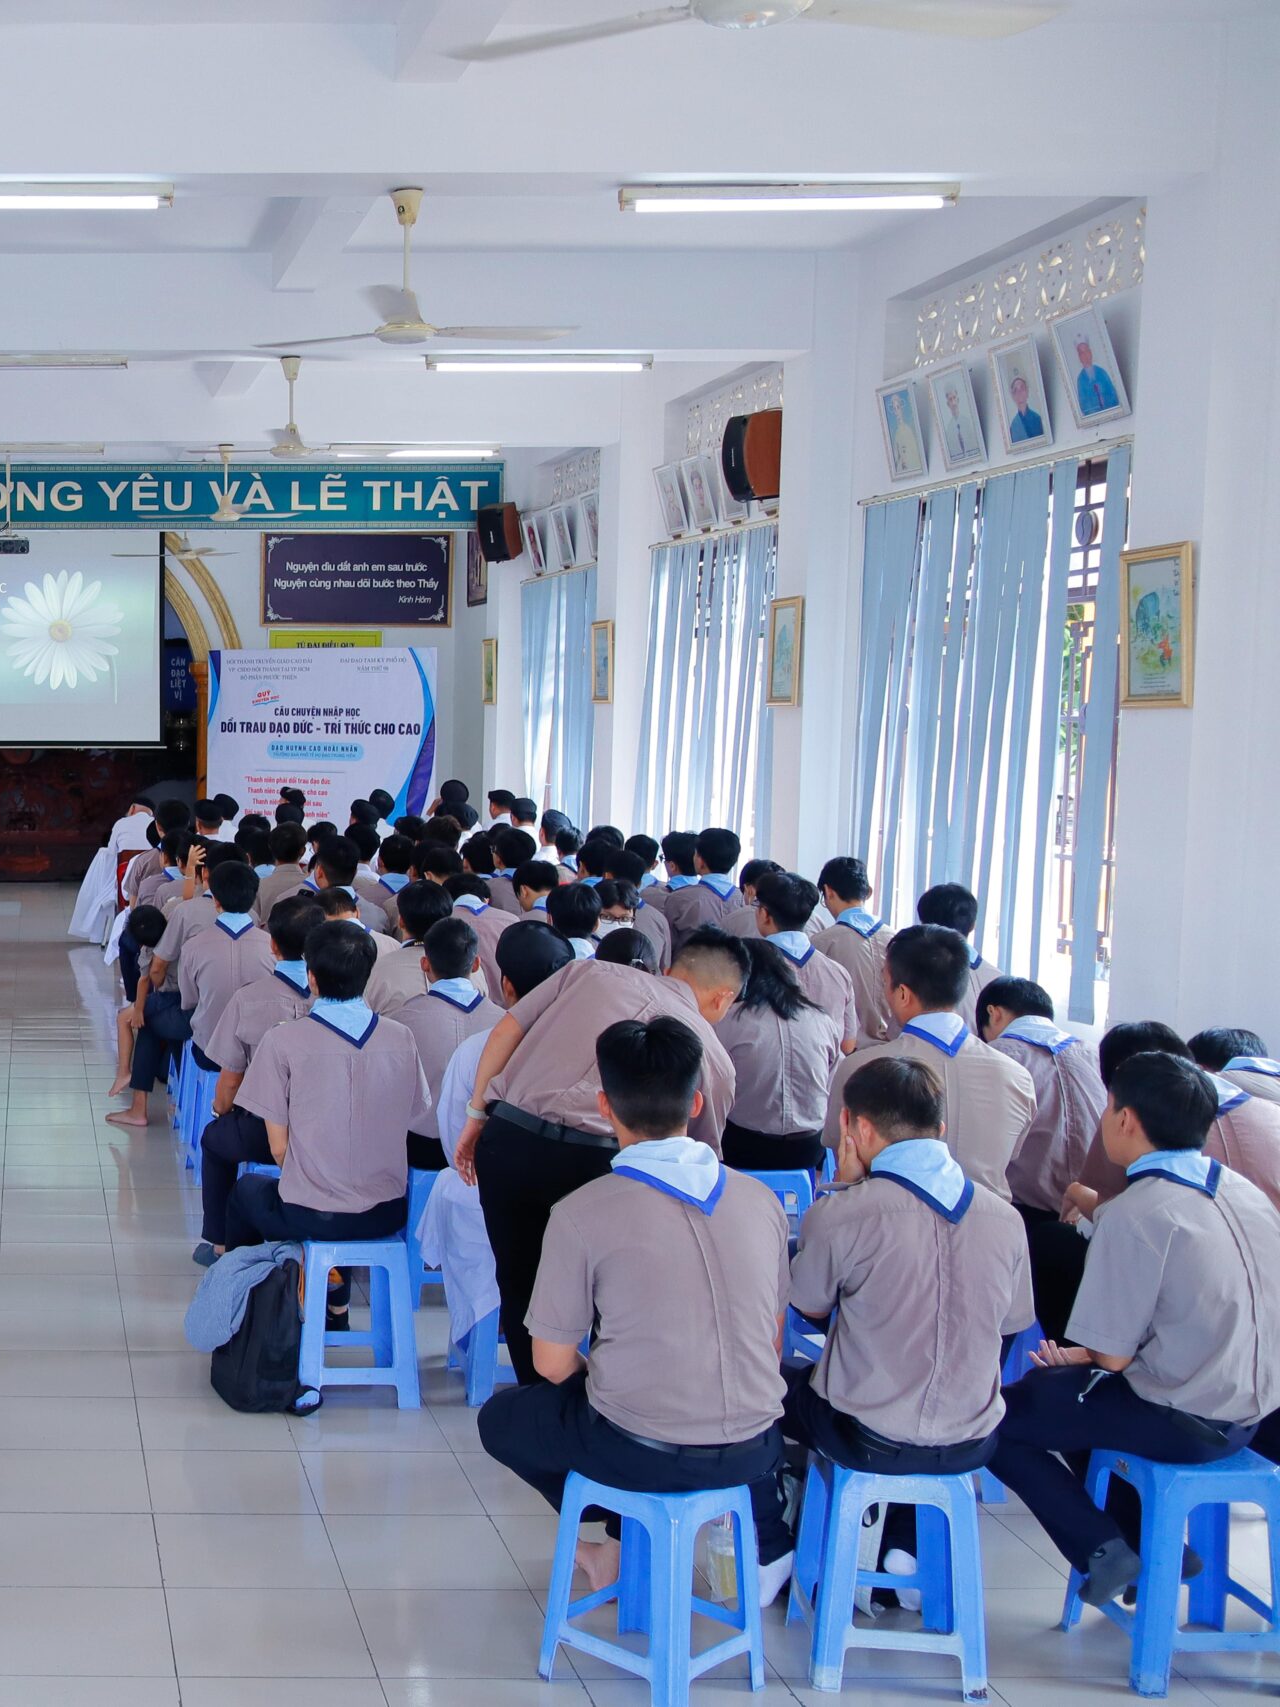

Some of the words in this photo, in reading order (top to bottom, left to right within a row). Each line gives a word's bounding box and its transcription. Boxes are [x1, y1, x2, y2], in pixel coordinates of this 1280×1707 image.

[97, 473, 192, 511] YÊU
[209, 473, 275, 511] VÀ
[290, 473, 347, 511] LẼ
[363, 475, 488, 518] THẬT
[286, 561, 319, 573] Nguyện
[353, 562, 369, 571] anh
[371, 564, 385, 572] em
[388, 564, 403, 572] sau
[405, 561, 428, 572] trước
[273, 578, 307, 590] Nguyện
[309, 578, 331, 590] cùng
[333, 578, 355, 588] nhau
[373, 578, 395, 588] bước
[396, 578, 416, 588] theo
[417, 577, 439, 591] Thầy
[398, 596, 414, 604] Kinh
[274, 706, 289, 716] CÂU
[291, 706, 321, 720] CHUYỆN
[323, 706, 344, 720] NHẬP
[346, 708, 361, 720] HỌC
[220, 717, 236, 733] DỒI
[239, 722, 266, 733] TRAU
[269, 722, 290, 738] ĐẠO
[293, 720, 313, 734] ĐỨC
[324, 720, 341, 734] TRÍ
[344, 720, 371, 734] THỨC
[374, 723, 395, 735] CHO
[398, 723, 421, 735] CAO
